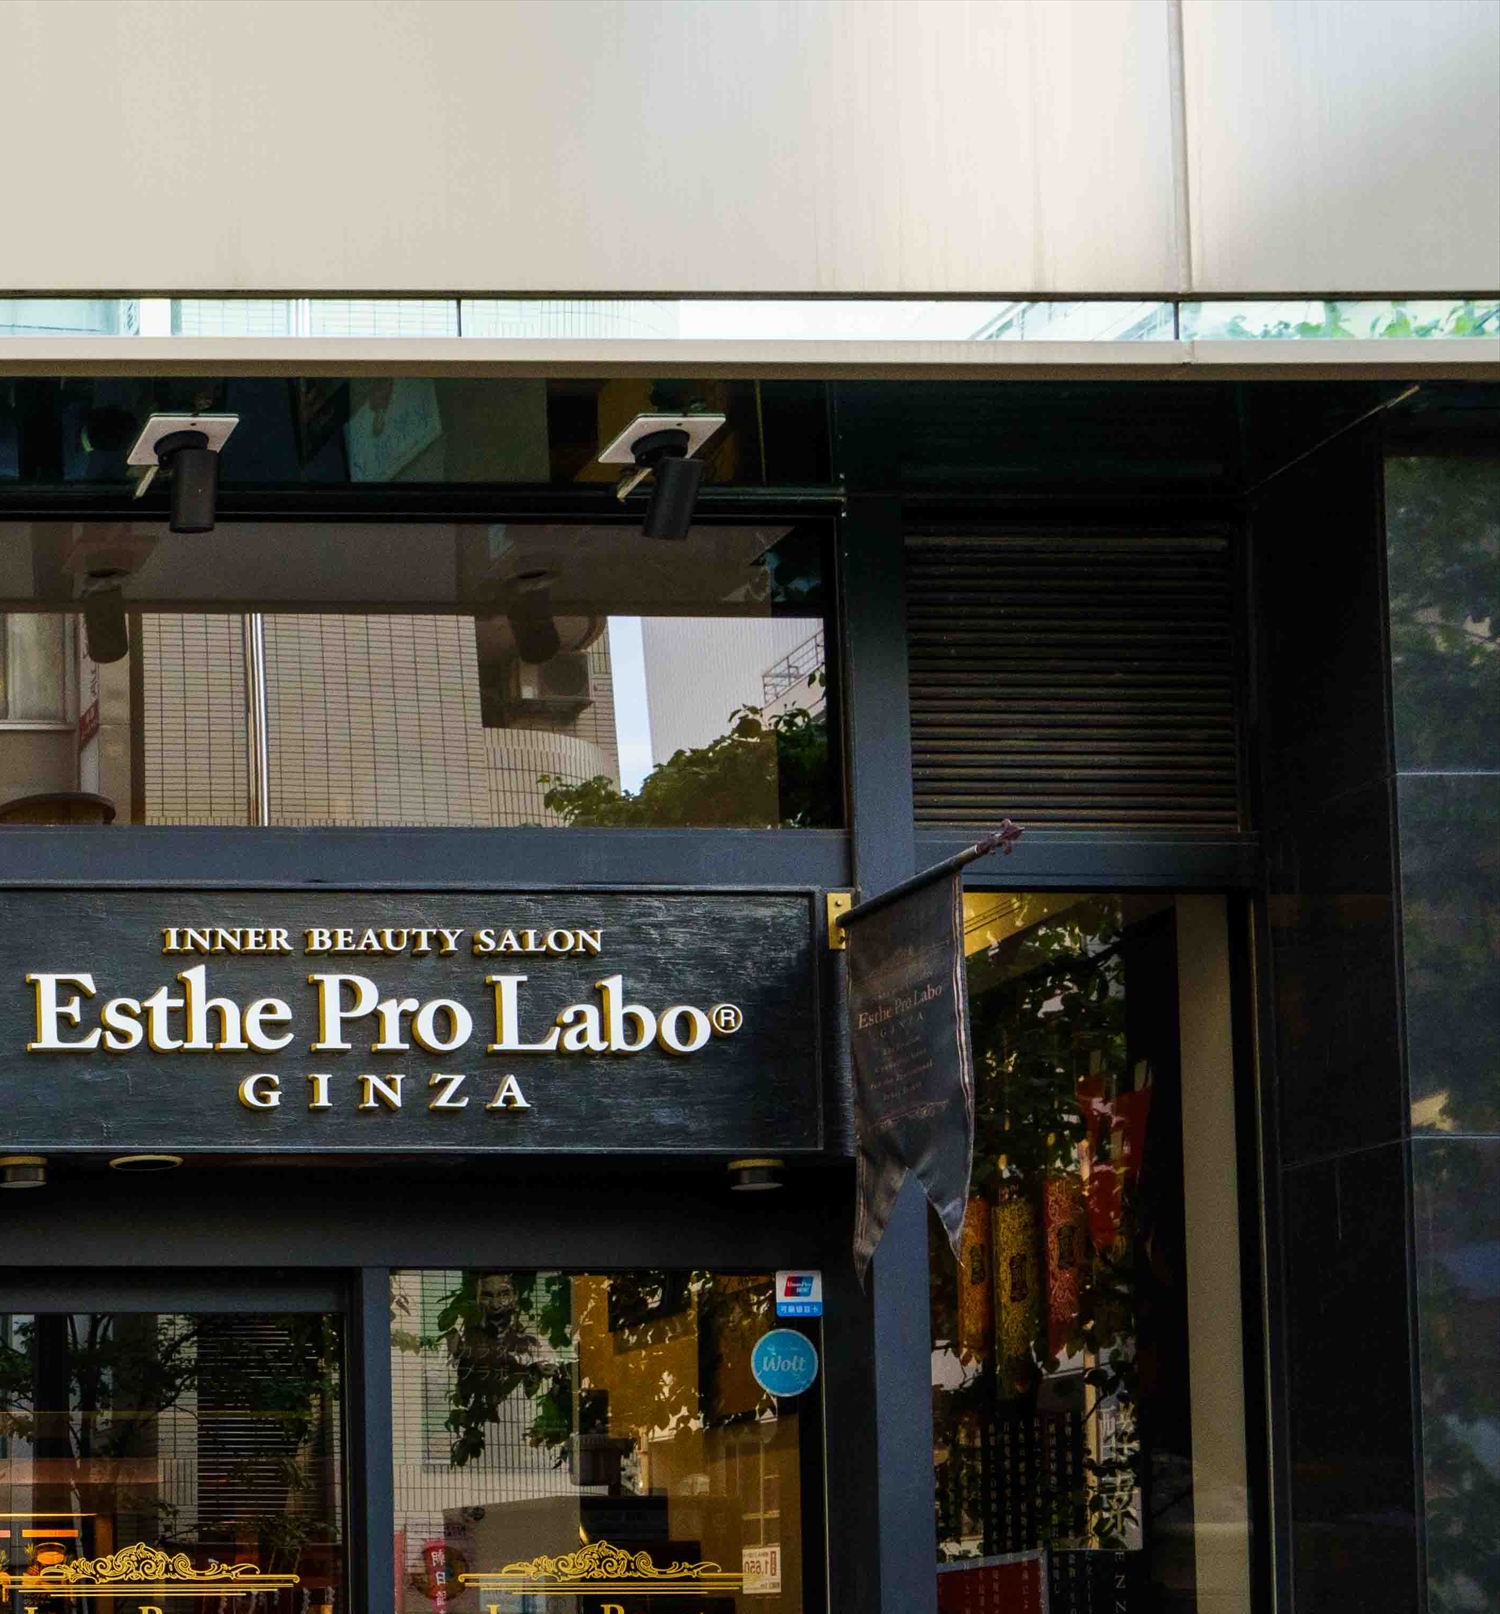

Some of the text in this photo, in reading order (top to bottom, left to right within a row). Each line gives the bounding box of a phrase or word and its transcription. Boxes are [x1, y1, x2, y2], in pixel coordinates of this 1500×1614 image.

[162, 927, 604, 957] INNER BEAUTY SALON
[25, 964, 295, 1055] Esthe
[308, 973, 474, 1055] Pro
[858, 1005, 893, 1030] Esthe
[914, 984, 943, 1005] Labo
[238, 1073, 532, 1112] GINZA
[762, 1355, 806, 1373] Wolt
